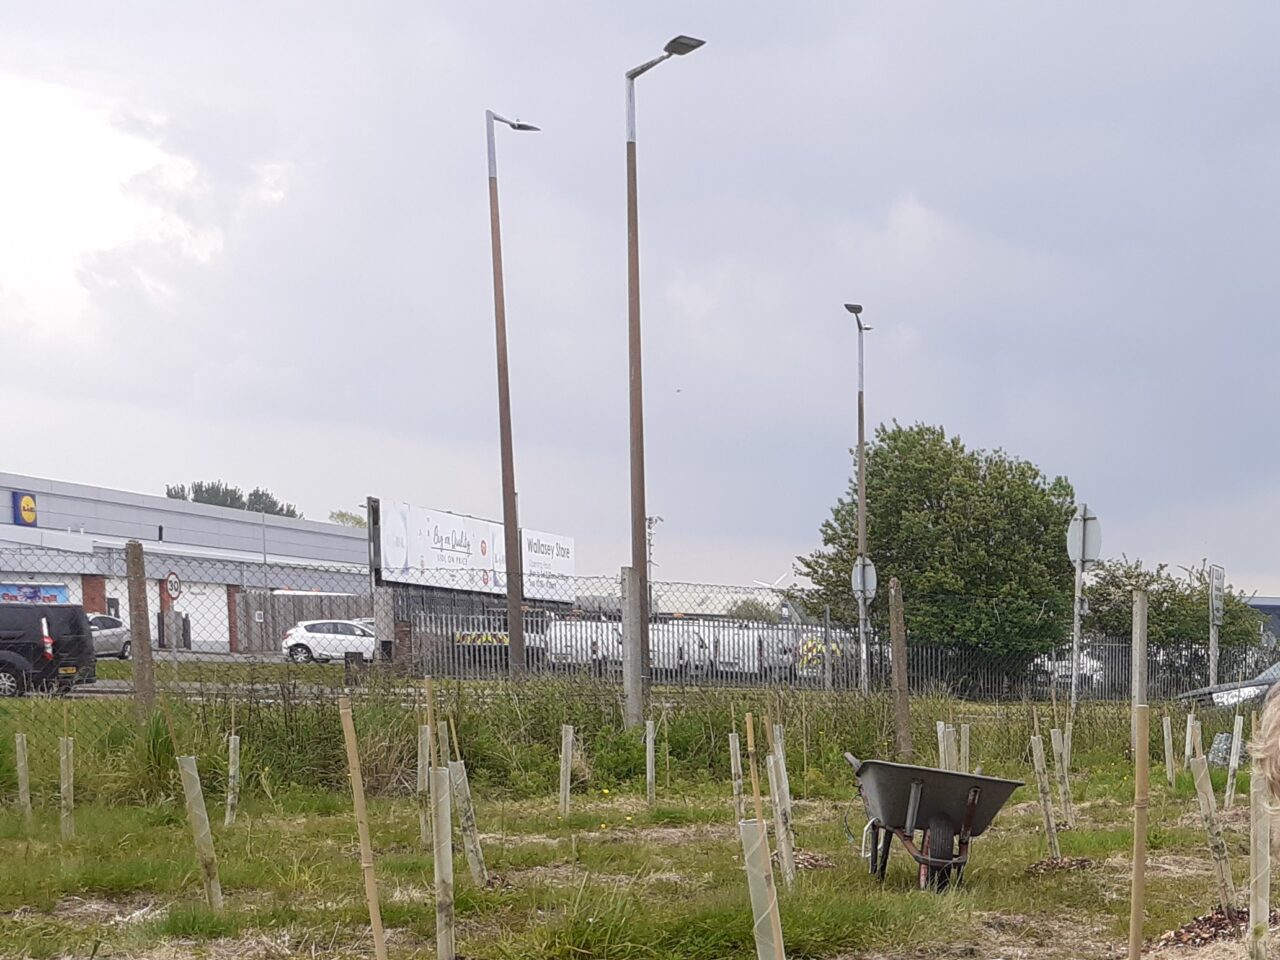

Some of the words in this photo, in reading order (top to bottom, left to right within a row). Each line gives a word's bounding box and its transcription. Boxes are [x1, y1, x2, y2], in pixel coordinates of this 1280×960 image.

[527, 537, 555, 559] Wallasey
[555, 542, 570, 559] Store
[169, 580, 178, 592] 30
